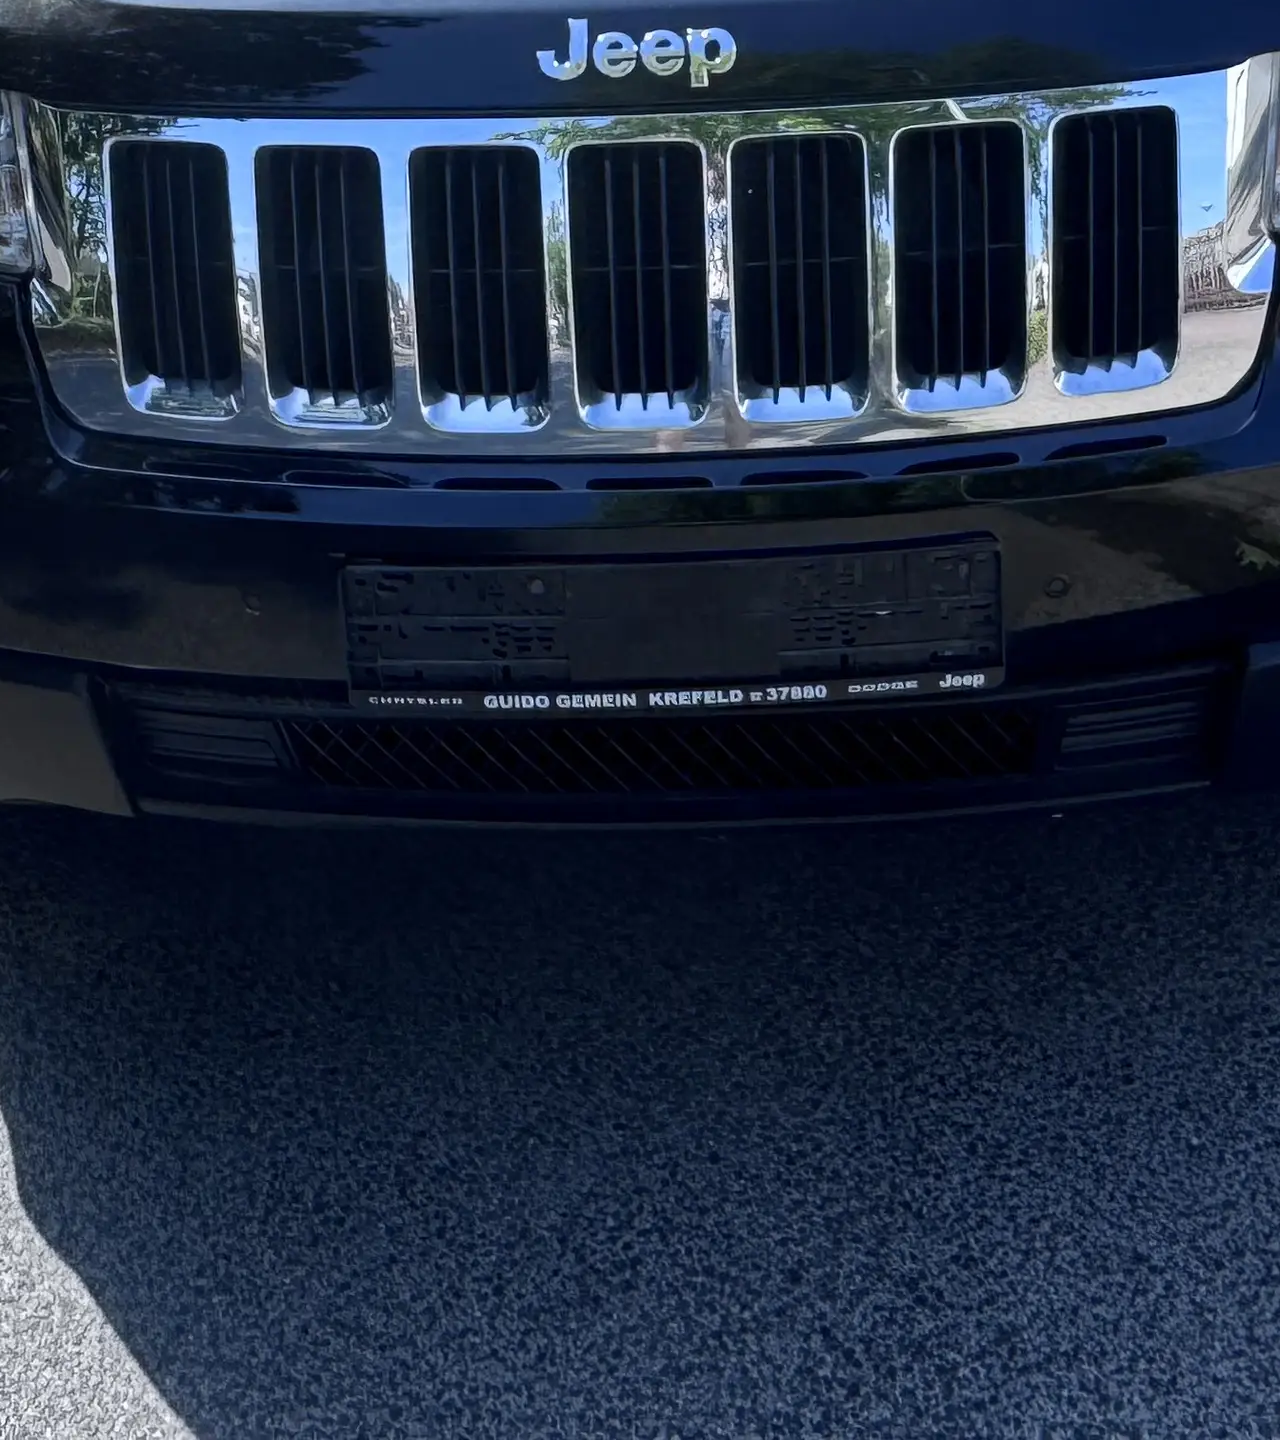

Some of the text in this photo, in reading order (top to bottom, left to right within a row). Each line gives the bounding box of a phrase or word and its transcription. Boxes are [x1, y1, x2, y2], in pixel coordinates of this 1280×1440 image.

[536, 18, 737, 88] Jeep
[484, 695, 550, 709] GUIDO
[555, 693, 637, 709] GEMEIN
[649, 689, 744, 706] KREFELD
[939, 673, 985, 689] Jeep
